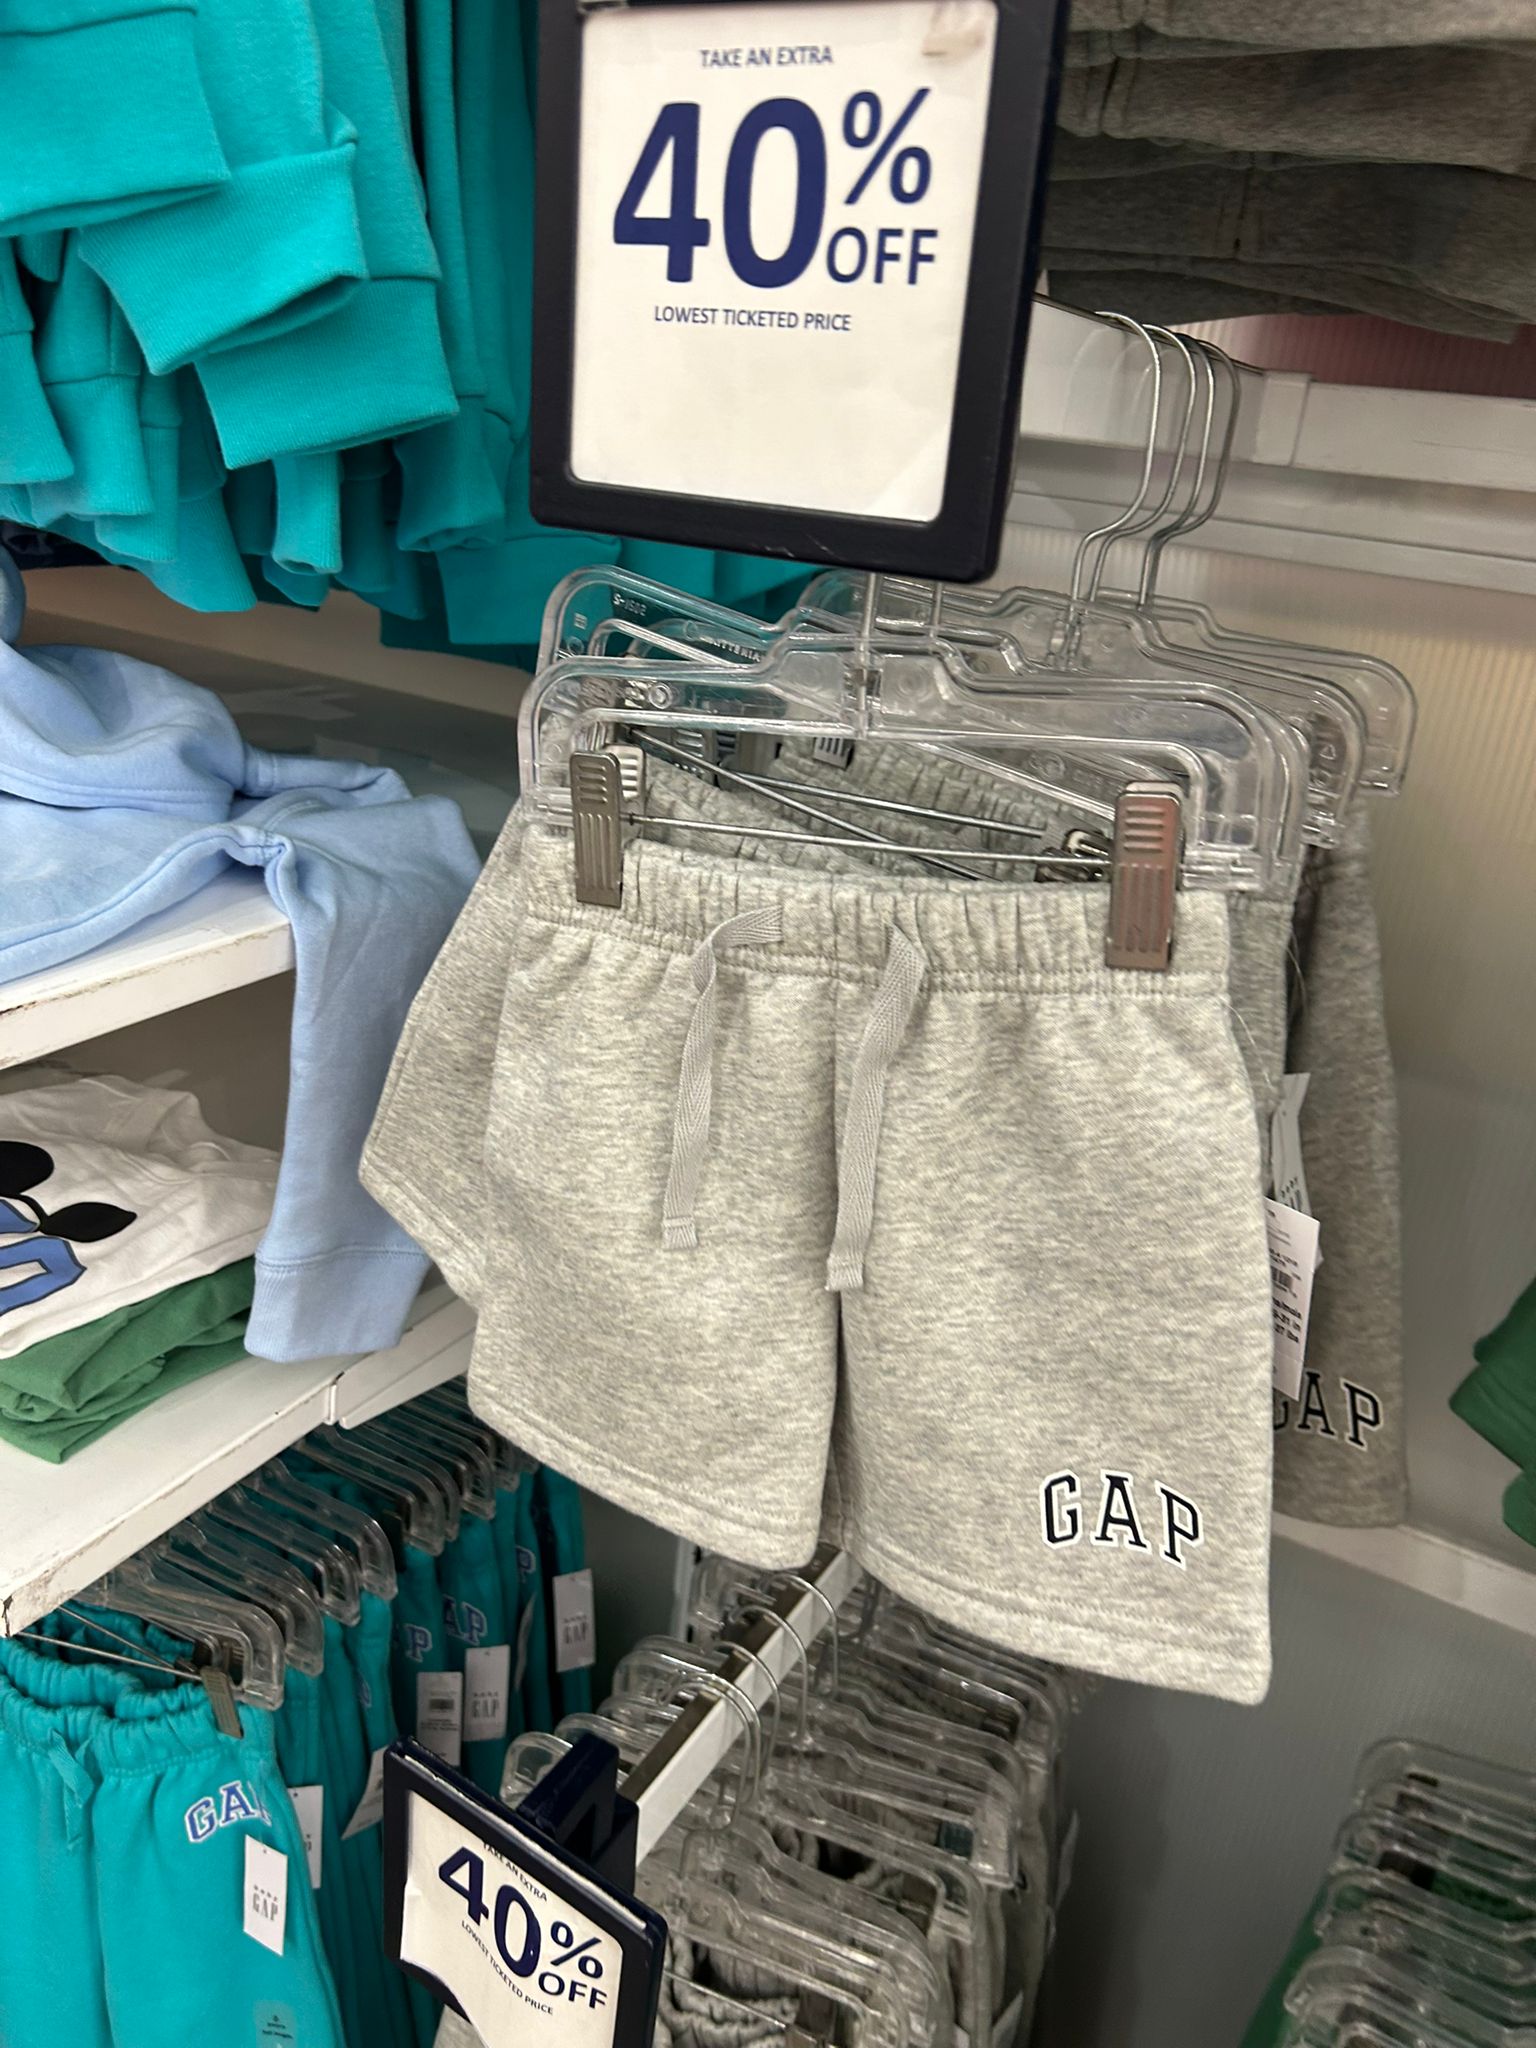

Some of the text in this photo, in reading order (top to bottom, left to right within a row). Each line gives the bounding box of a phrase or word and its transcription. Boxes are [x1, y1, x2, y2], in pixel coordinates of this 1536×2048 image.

[699, 45, 832, 67] TAKE AN EXTRA
[613, 88, 930, 288] 40%
[827, 226, 938, 284] OFF
[655, 305, 851, 331] LOWEST TICKETED PRICE
[1041, 1469, 1203, 1571] GAP
[252, 1892, 279, 1921] GAP
[520, 1873, 547, 1901] EXTRA
[439, 1847, 603, 1979] 40%
[461, 1920, 554, 2014] LOWEST TICKETED PRICE
[538, 1971, 608, 2009] OFF
